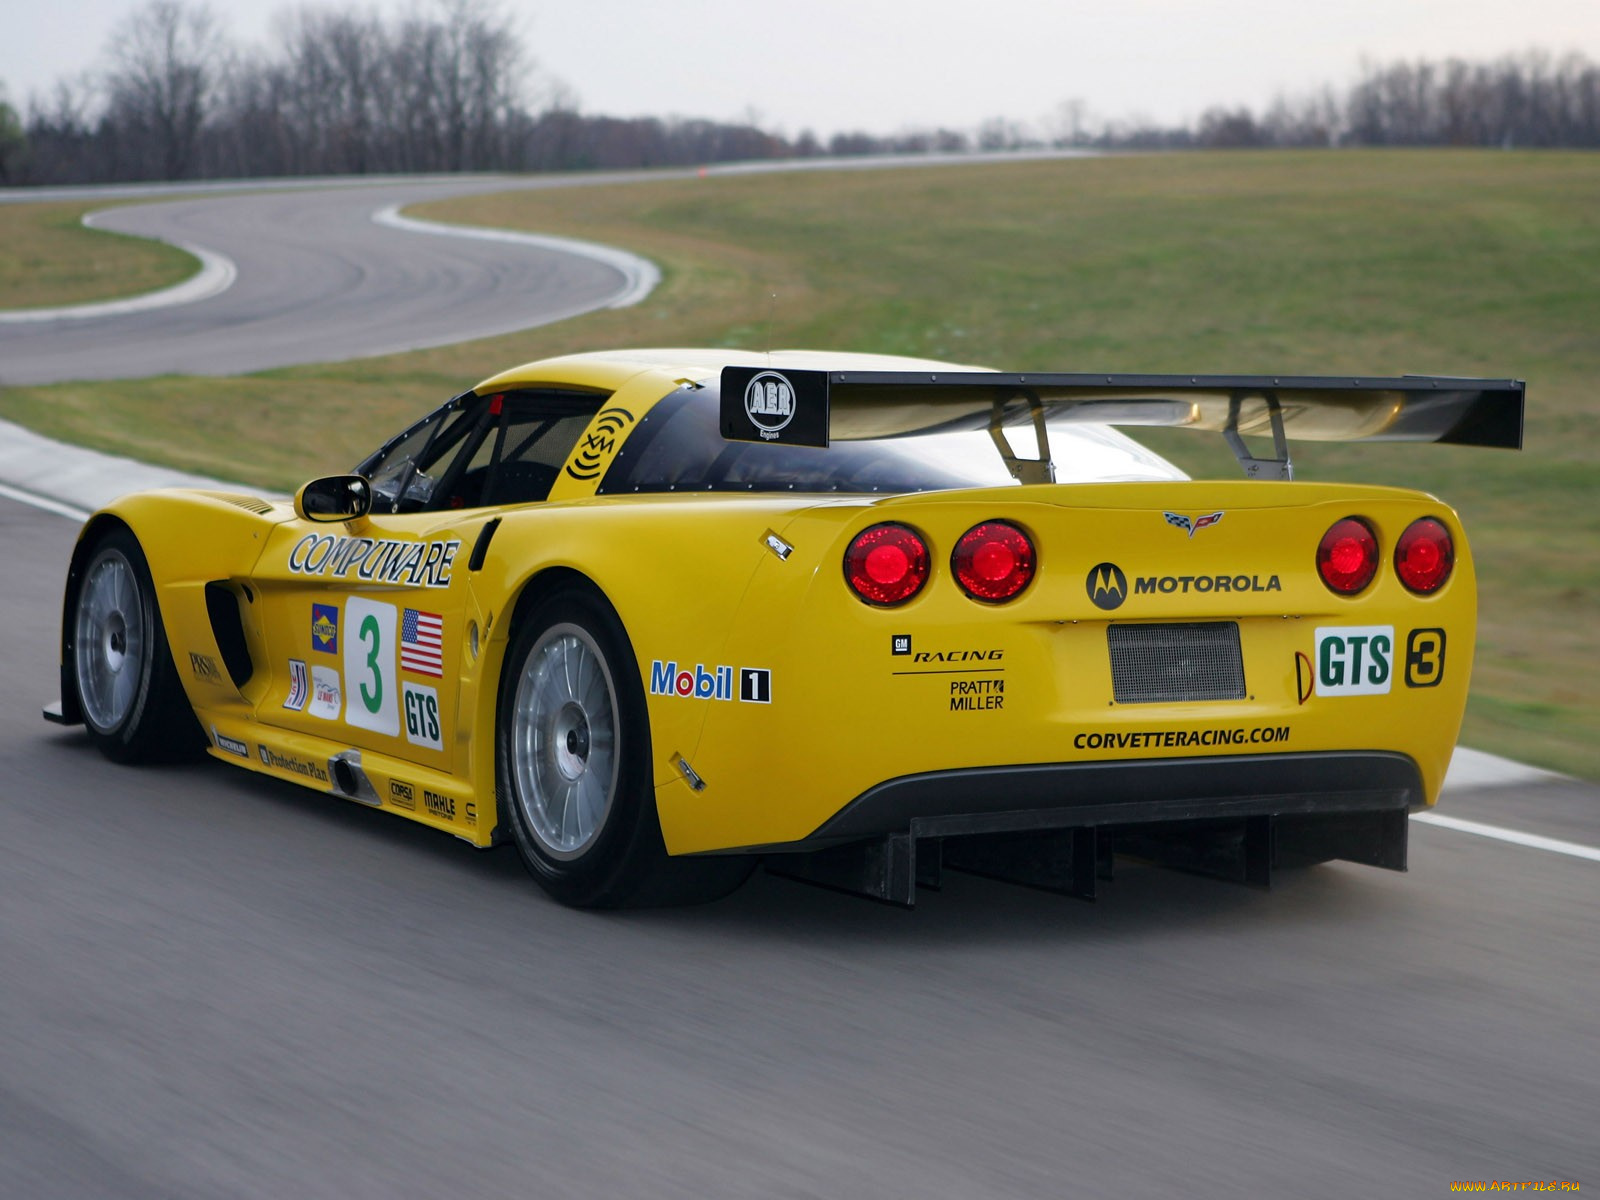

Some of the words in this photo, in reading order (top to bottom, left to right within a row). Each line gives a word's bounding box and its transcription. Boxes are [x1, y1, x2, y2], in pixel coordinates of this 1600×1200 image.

[750, 381, 790, 415] AER
[581, 433, 615, 454] XM
[760, 429, 779, 440] Engines
[288, 532, 461, 588] COMPUWARE
[1134, 575, 1282, 595] MOTOROLA
[895, 638, 908, 651] GM
[913, 649, 1004, 663] RACING
[1319, 635, 1392, 688] GTS
[1410, 631, 1441, 684] 3
[359, 614, 383, 714] 3
[651, 660, 732, 700] Mobil
[950, 680, 992, 695] PRATT
[404, 689, 439, 742] GTS
[950, 696, 1004, 711] MILLER
[1073, 726, 1291, 750] CORVETTERACING.COM
[268, 750, 309, 777] Protection
[307, 761, 329, 782] Plan
[391, 782, 413, 802] CORSA
[423, 790, 456, 816] MAHLE
